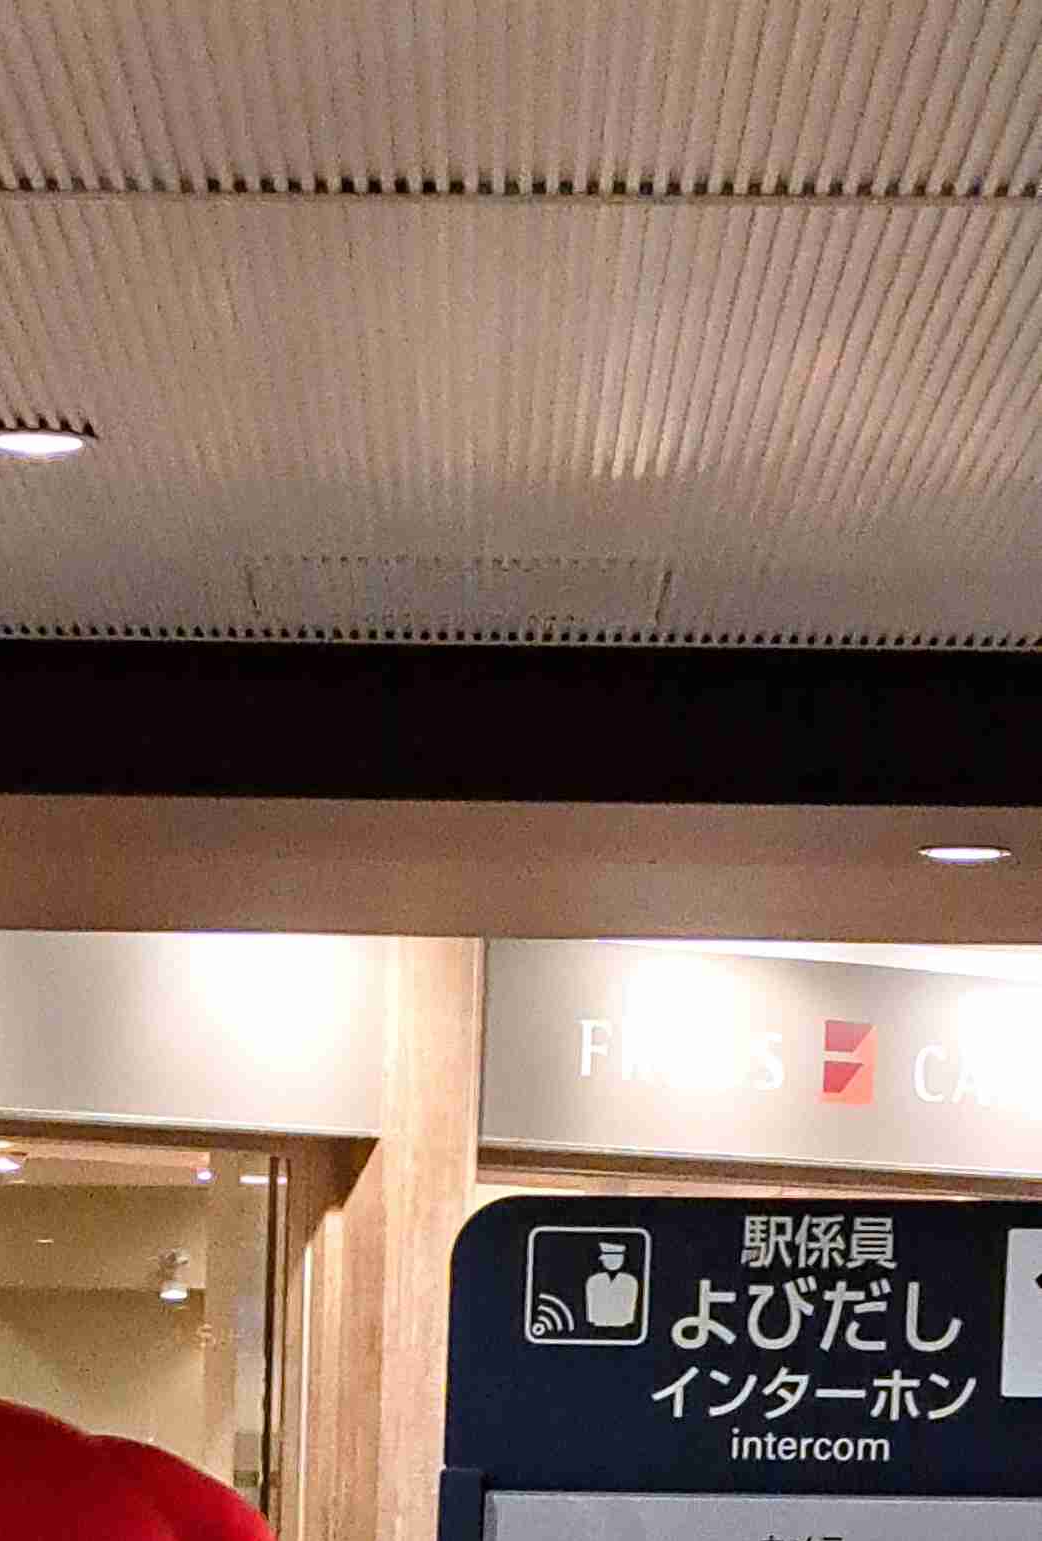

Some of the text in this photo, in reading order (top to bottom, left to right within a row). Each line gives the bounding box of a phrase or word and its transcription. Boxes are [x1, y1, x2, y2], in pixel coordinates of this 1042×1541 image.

[741, 1215, 897, 1269] 駅係員
[671, 1276, 963, 1352] よびだし
[652, 1366, 977, 1422] インターホン
[731, 1428, 891, 1463] intercom
